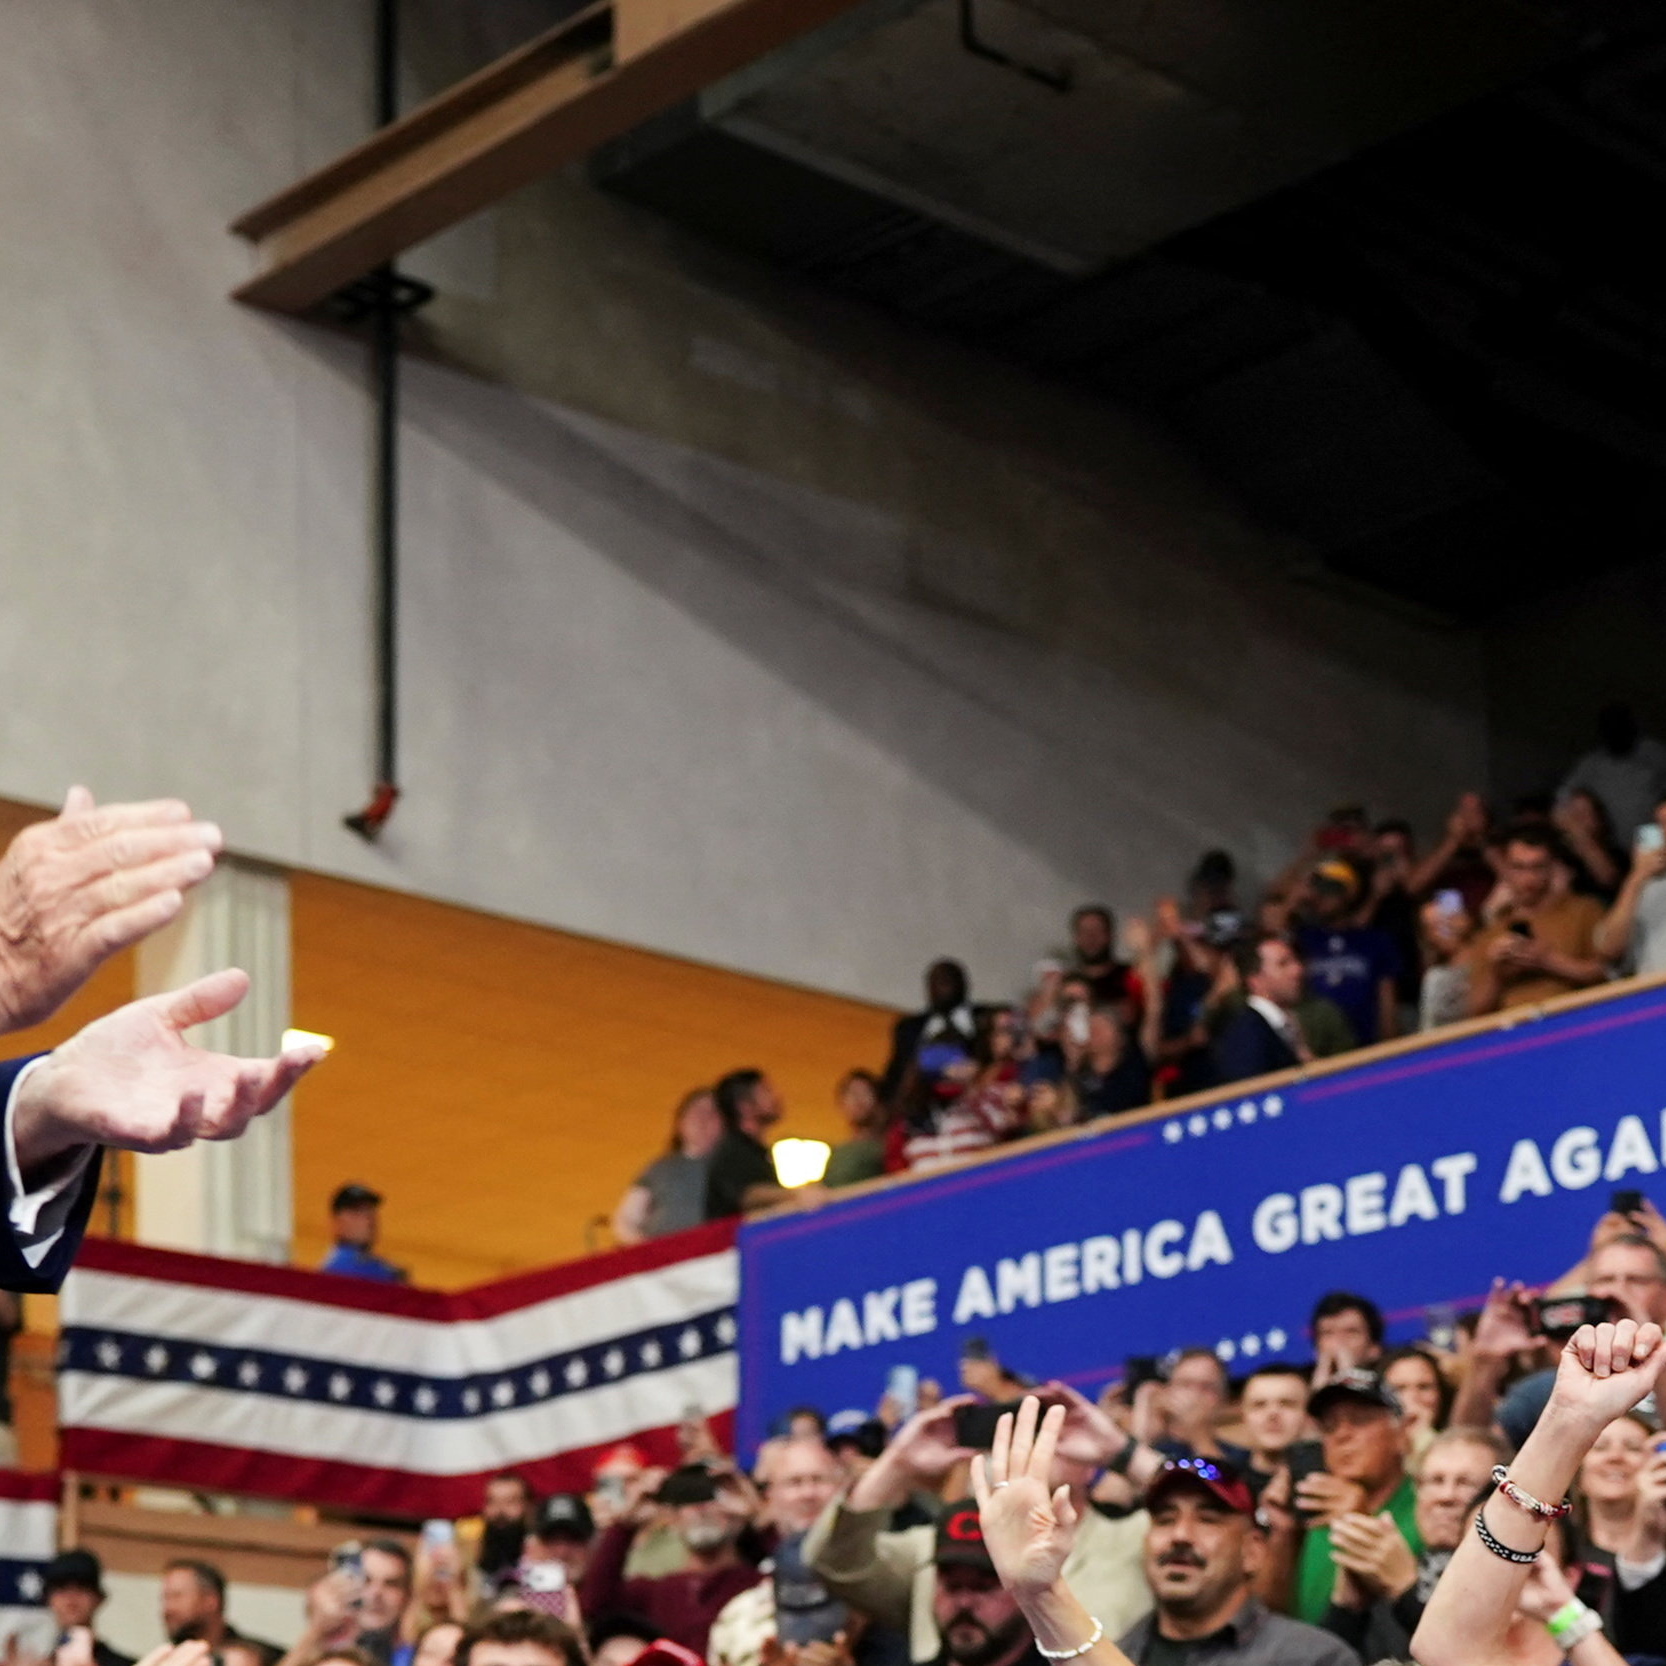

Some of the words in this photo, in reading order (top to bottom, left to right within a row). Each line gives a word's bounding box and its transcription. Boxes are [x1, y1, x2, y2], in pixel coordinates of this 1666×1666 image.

[779, 1277, 938, 1365] MAKE
[952, 1209, 1234, 1325] AMERICA
[1251, 1151, 1478, 1254] GREAT
